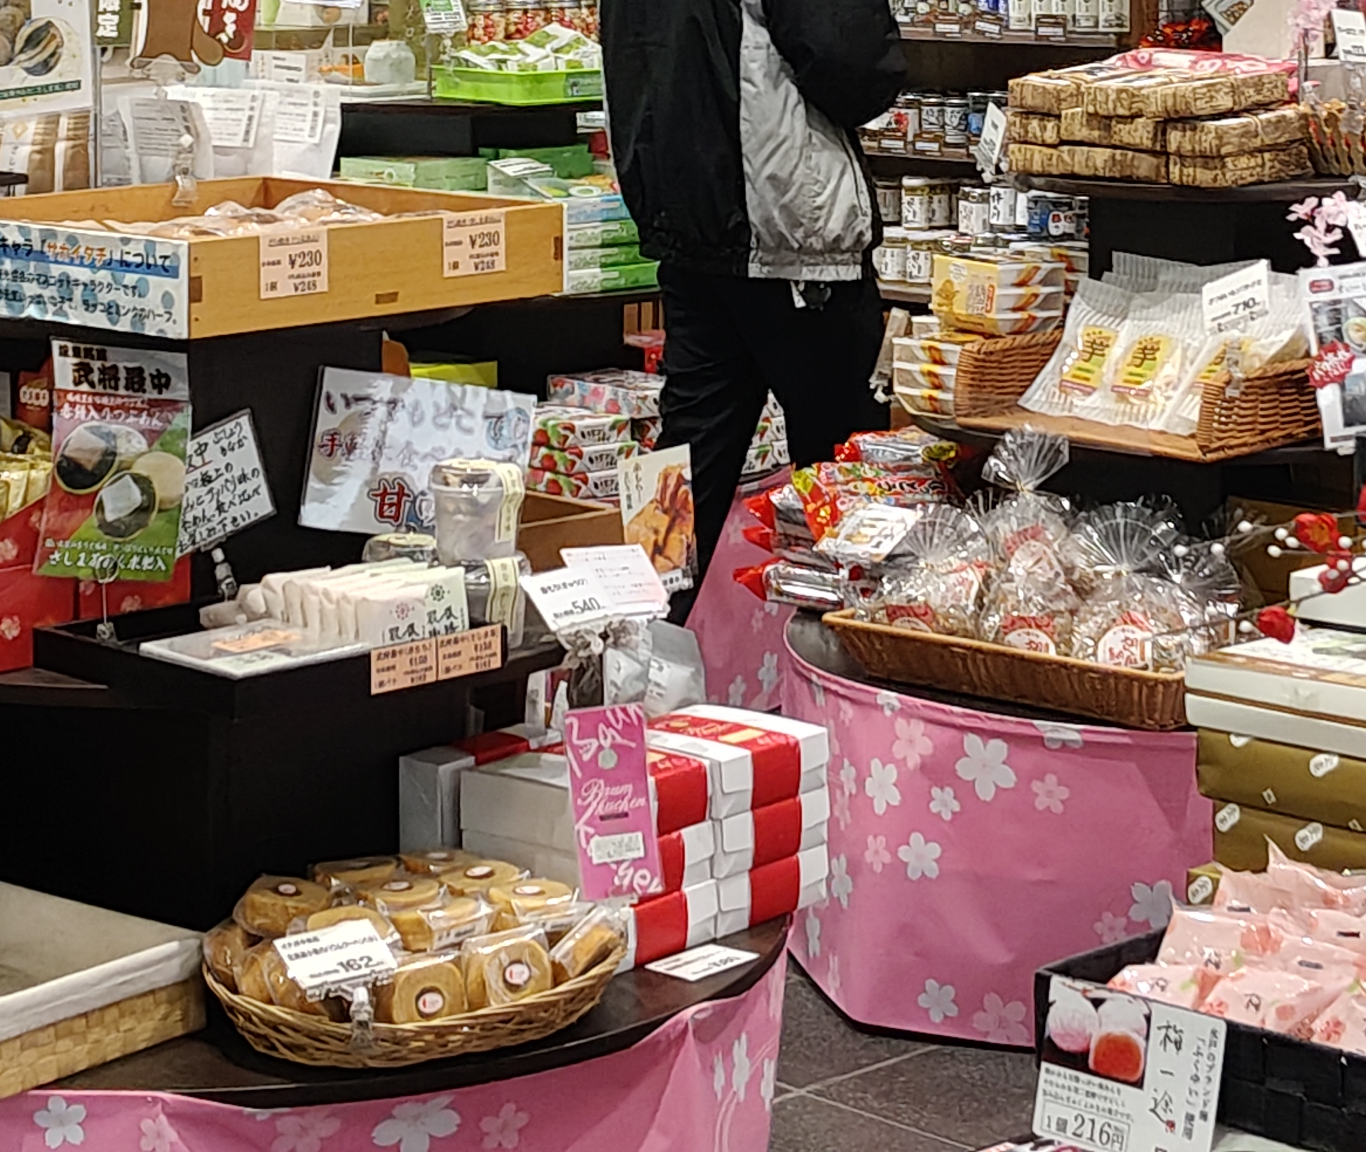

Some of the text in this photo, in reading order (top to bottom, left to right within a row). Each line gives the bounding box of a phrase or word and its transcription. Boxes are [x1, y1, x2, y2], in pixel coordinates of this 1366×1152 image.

[469, 230, 502, 249] ¥230
[288, 249, 323, 270] ¥230
[70, 360, 173, 396] 武将最中
[337, 954, 375, 973] 162
